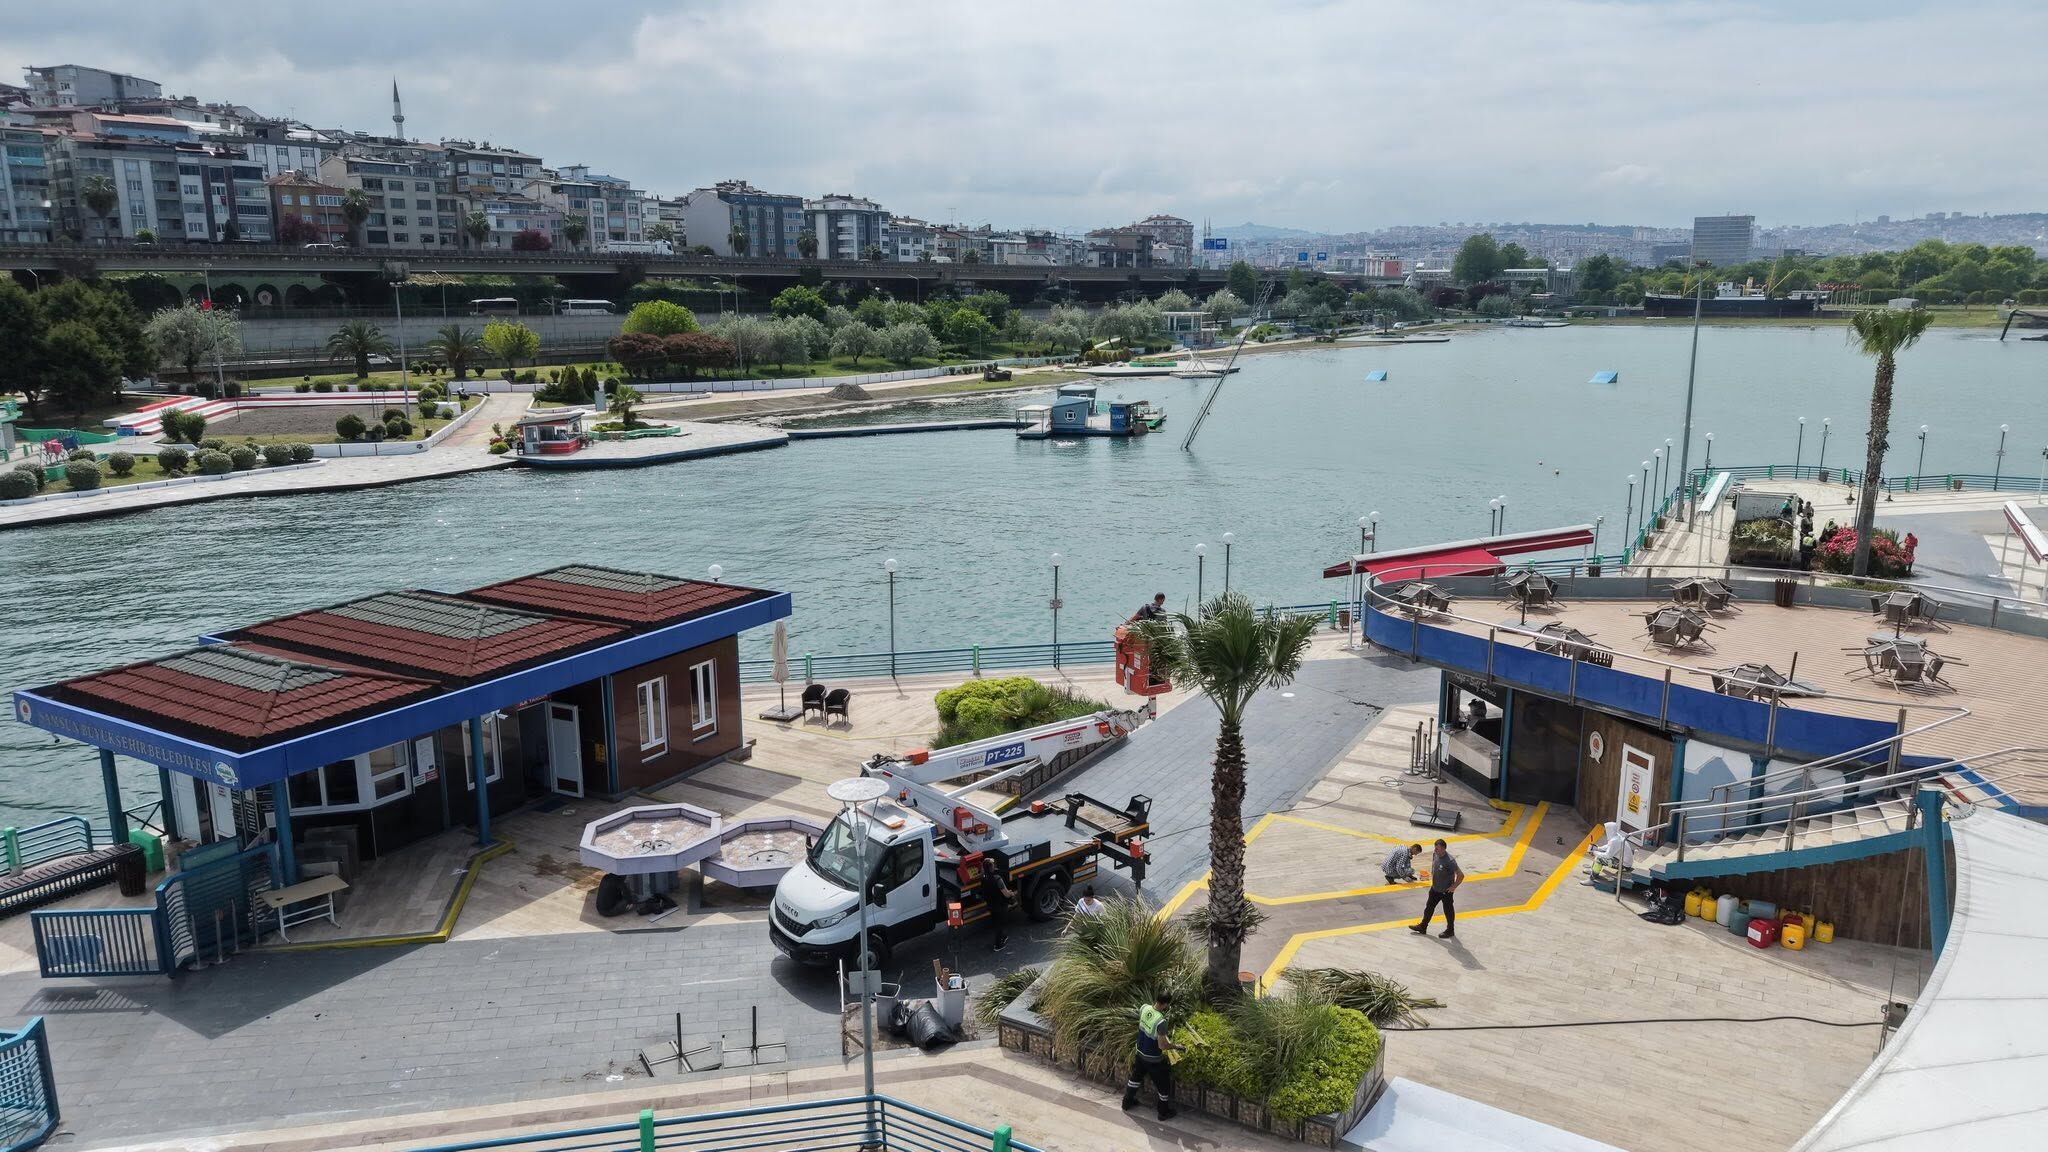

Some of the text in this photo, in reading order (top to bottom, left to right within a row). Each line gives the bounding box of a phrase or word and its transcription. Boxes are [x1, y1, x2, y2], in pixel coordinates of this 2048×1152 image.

[40, 714, 80, 734] SAMSUN
[987, 745, 1023, 762] PT-225
[782, 902, 799, 917] IVECO
